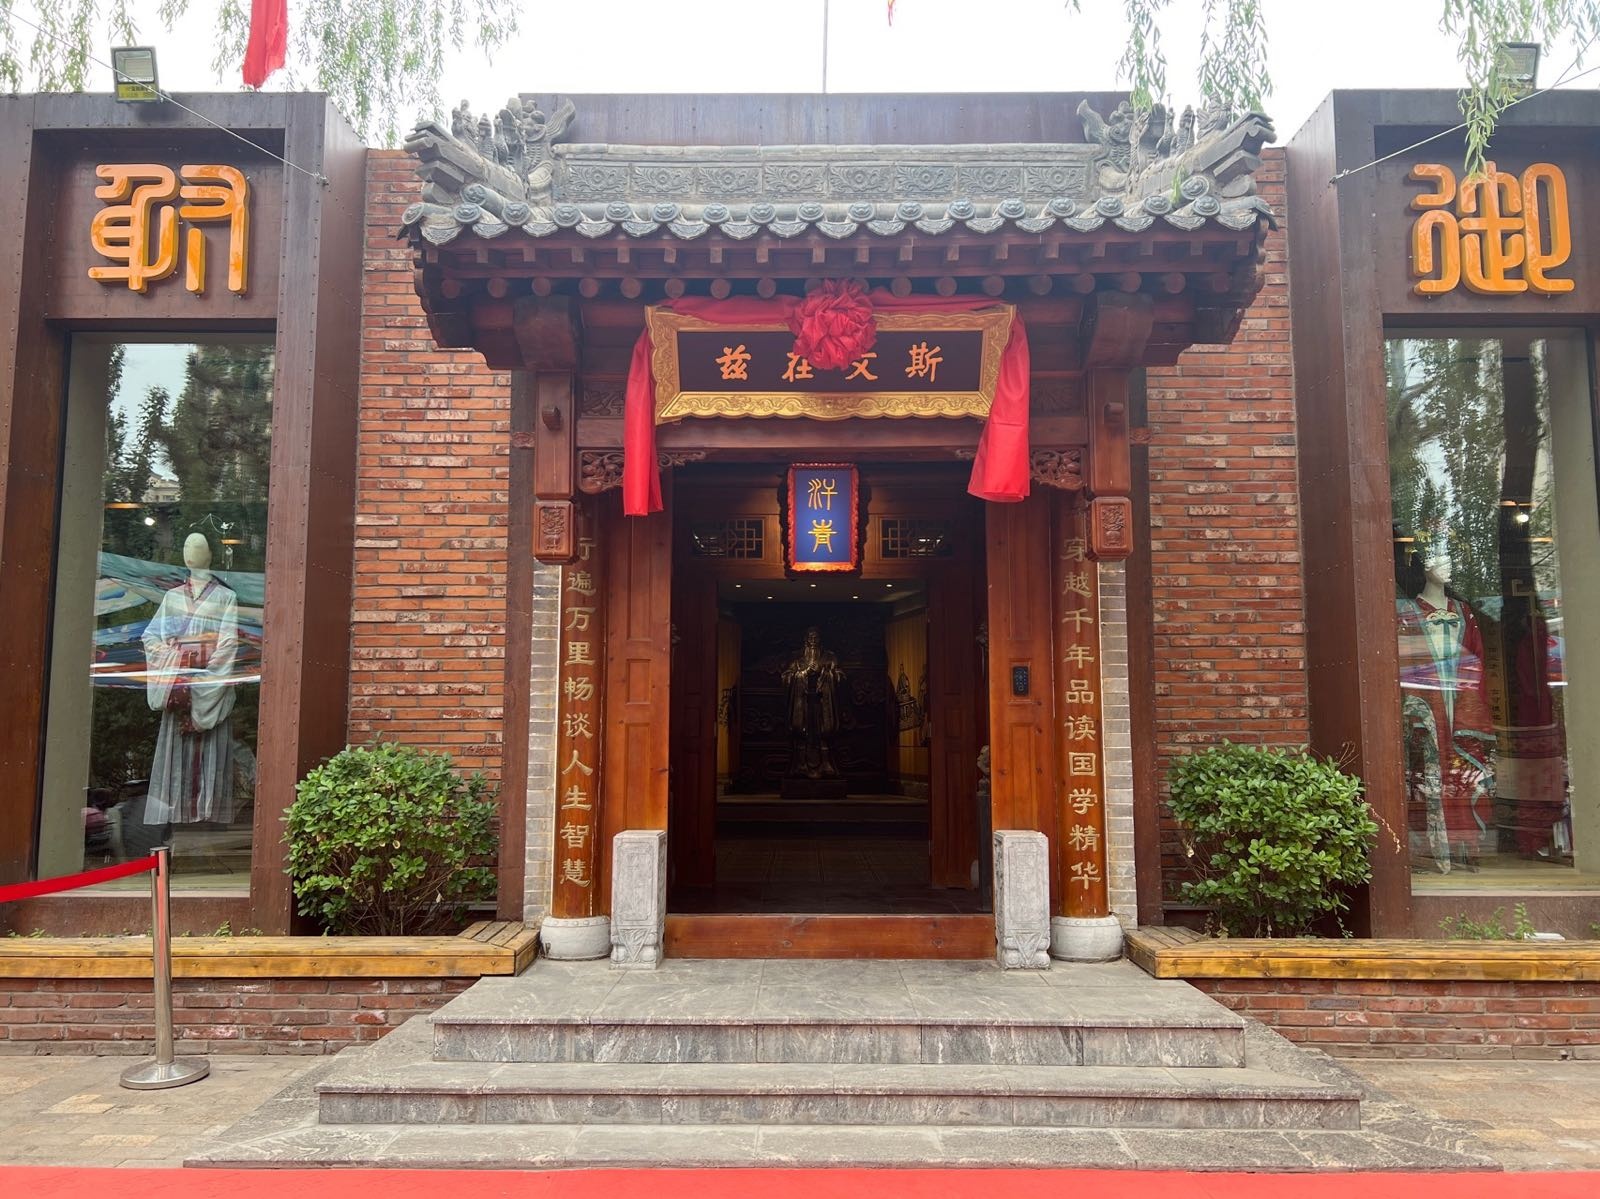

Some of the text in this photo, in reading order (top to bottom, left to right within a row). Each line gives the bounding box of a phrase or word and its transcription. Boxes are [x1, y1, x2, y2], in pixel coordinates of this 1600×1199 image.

[1059, 536, 1101, 891] 穿越千年品读国学精华
